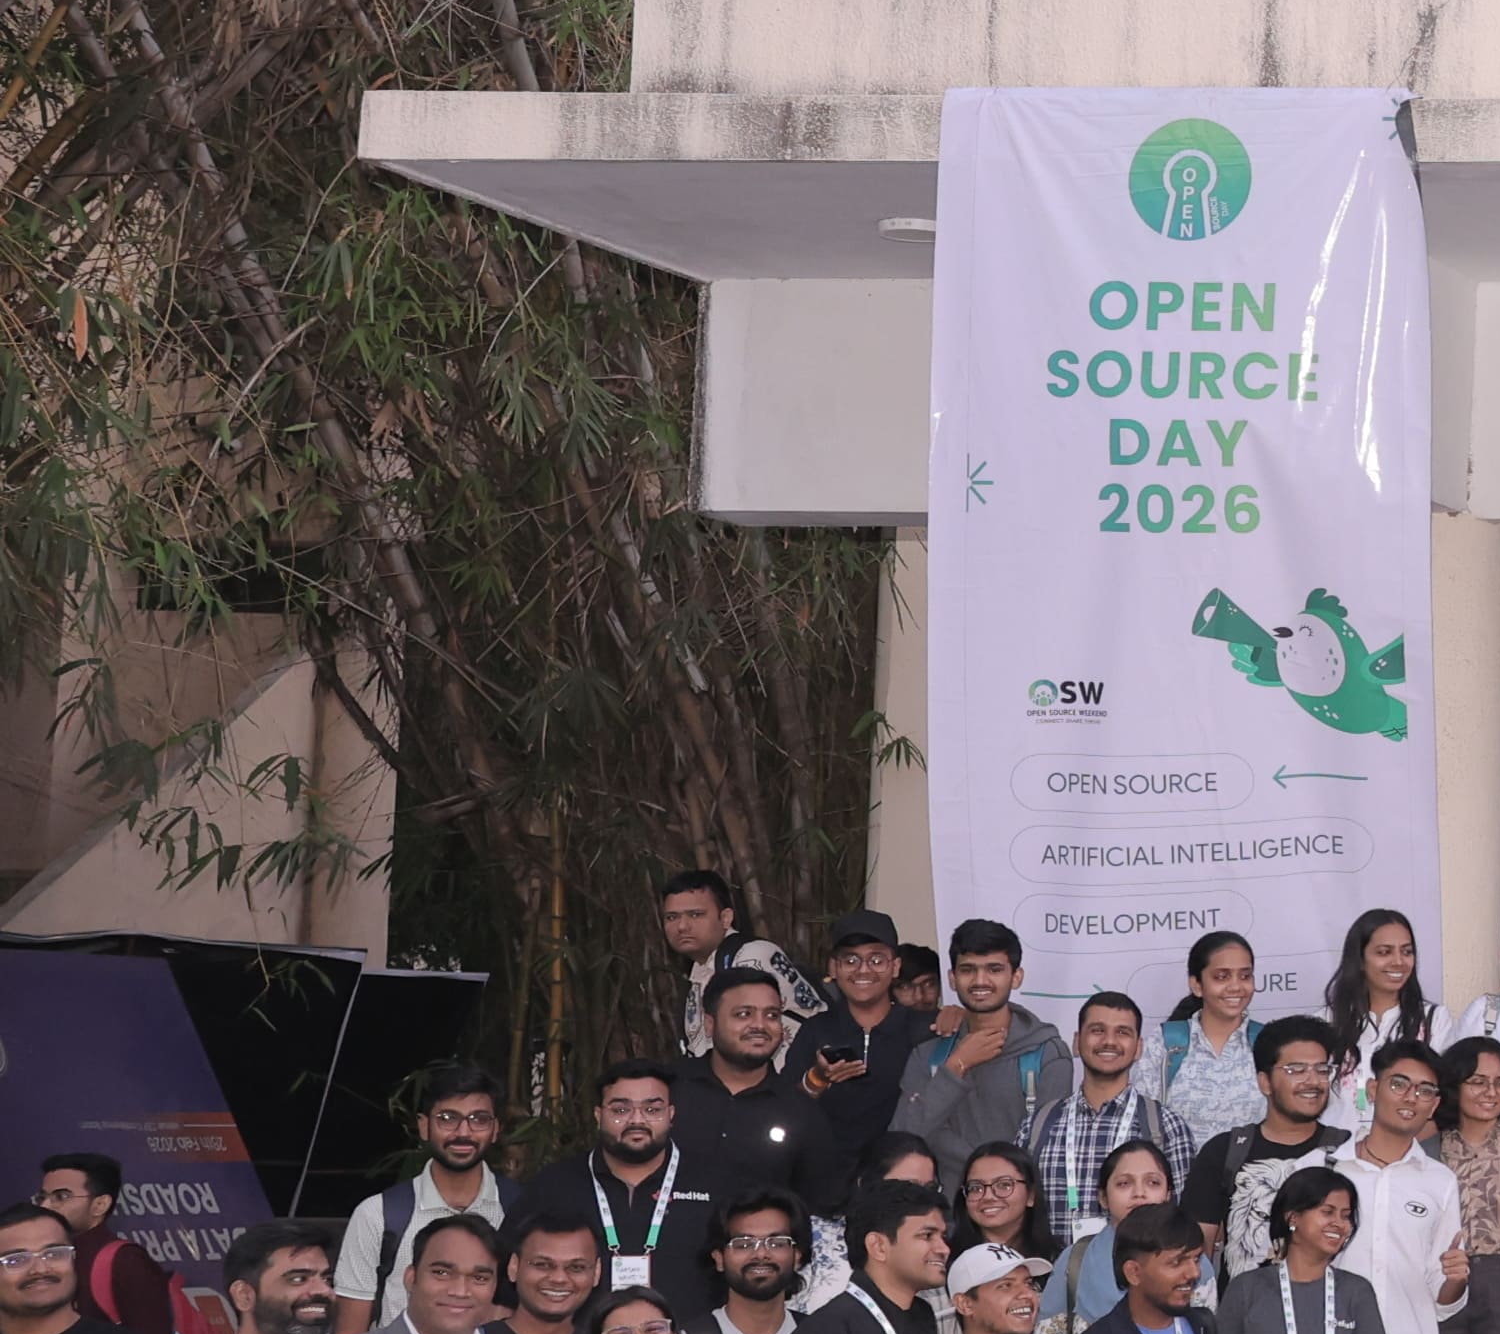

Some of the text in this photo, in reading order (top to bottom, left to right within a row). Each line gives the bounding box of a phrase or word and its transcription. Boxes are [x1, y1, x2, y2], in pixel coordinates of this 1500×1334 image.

[1180, 167, 1197, 238] OPEN
[1210, 196, 1221, 231] SOURCE
[1220, 201, 1229, 218] DAY
[1089, 281, 1278, 332] OPEN
[1046, 349, 1320, 402] SOURCE
[1109, 418, 1249, 468] DAY
[1098, 482, 1262, 534] 2026
[1047, 772, 1217, 795] OPEN SOURCE
[1041, 834, 1344, 867] ARTIFICIAL INTELLIGENCE
[1045, 908, 1221, 935] DEVELOPMENT
[673, 1191, 710, 1201] Red Hat
